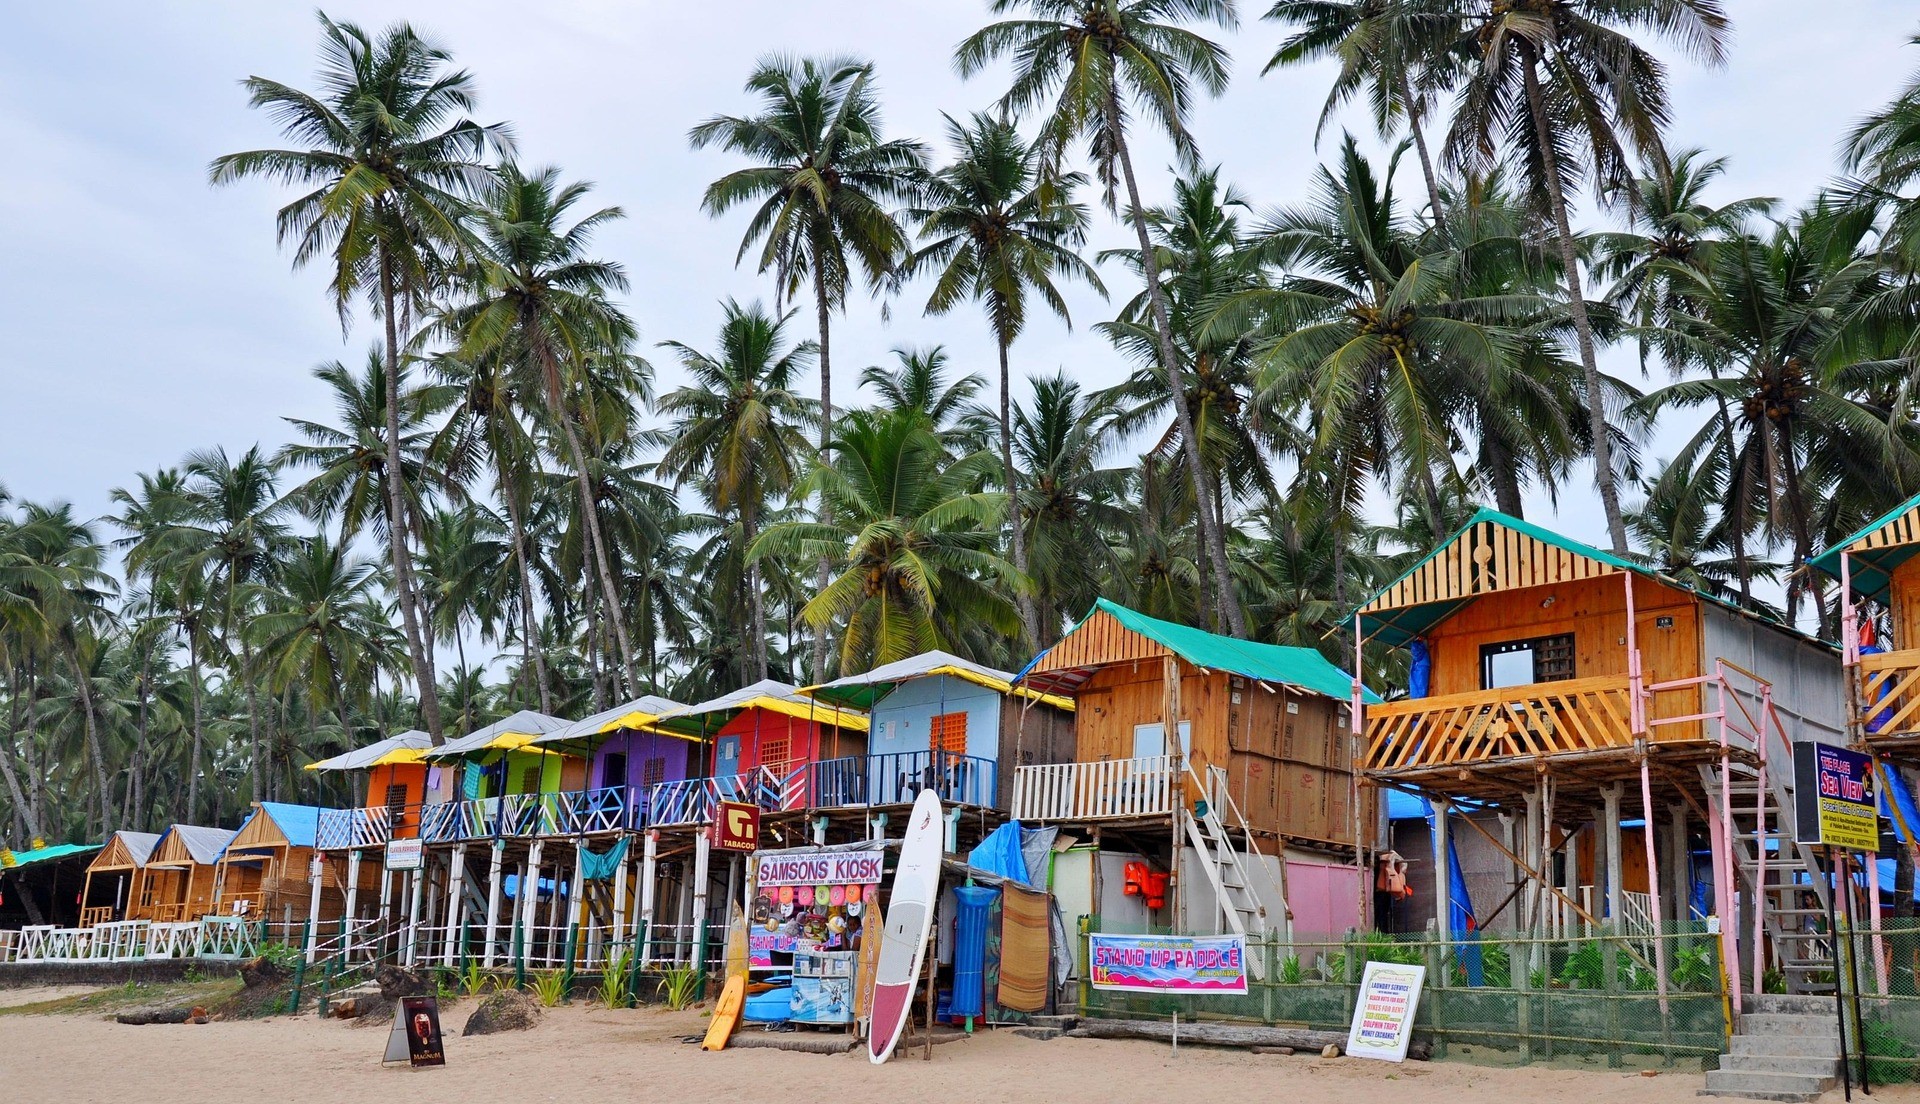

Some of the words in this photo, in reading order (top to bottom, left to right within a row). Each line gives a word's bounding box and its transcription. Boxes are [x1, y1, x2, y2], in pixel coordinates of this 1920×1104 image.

[1821, 756, 1833, 769] THE
[1840, 774, 1863, 801] VIEW
[723, 839, 756, 850] TABACOS
[760, 860, 829, 881] SAMSONS
[835, 857, 882, 879] KIOSK
[1095, 947, 1146, 967] STAND
[1150, 948, 1171, 968] UP
[1174, 948, 1240, 969] PADDLE
[1363, 1021, 1383, 1029] DOLPHIN
[1384, 1022, 1398, 1030] TRIPS
[1375, 1031, 1395, 1039] EXCHANGE
[413, 1052, 442, 1060] MAGNUM
